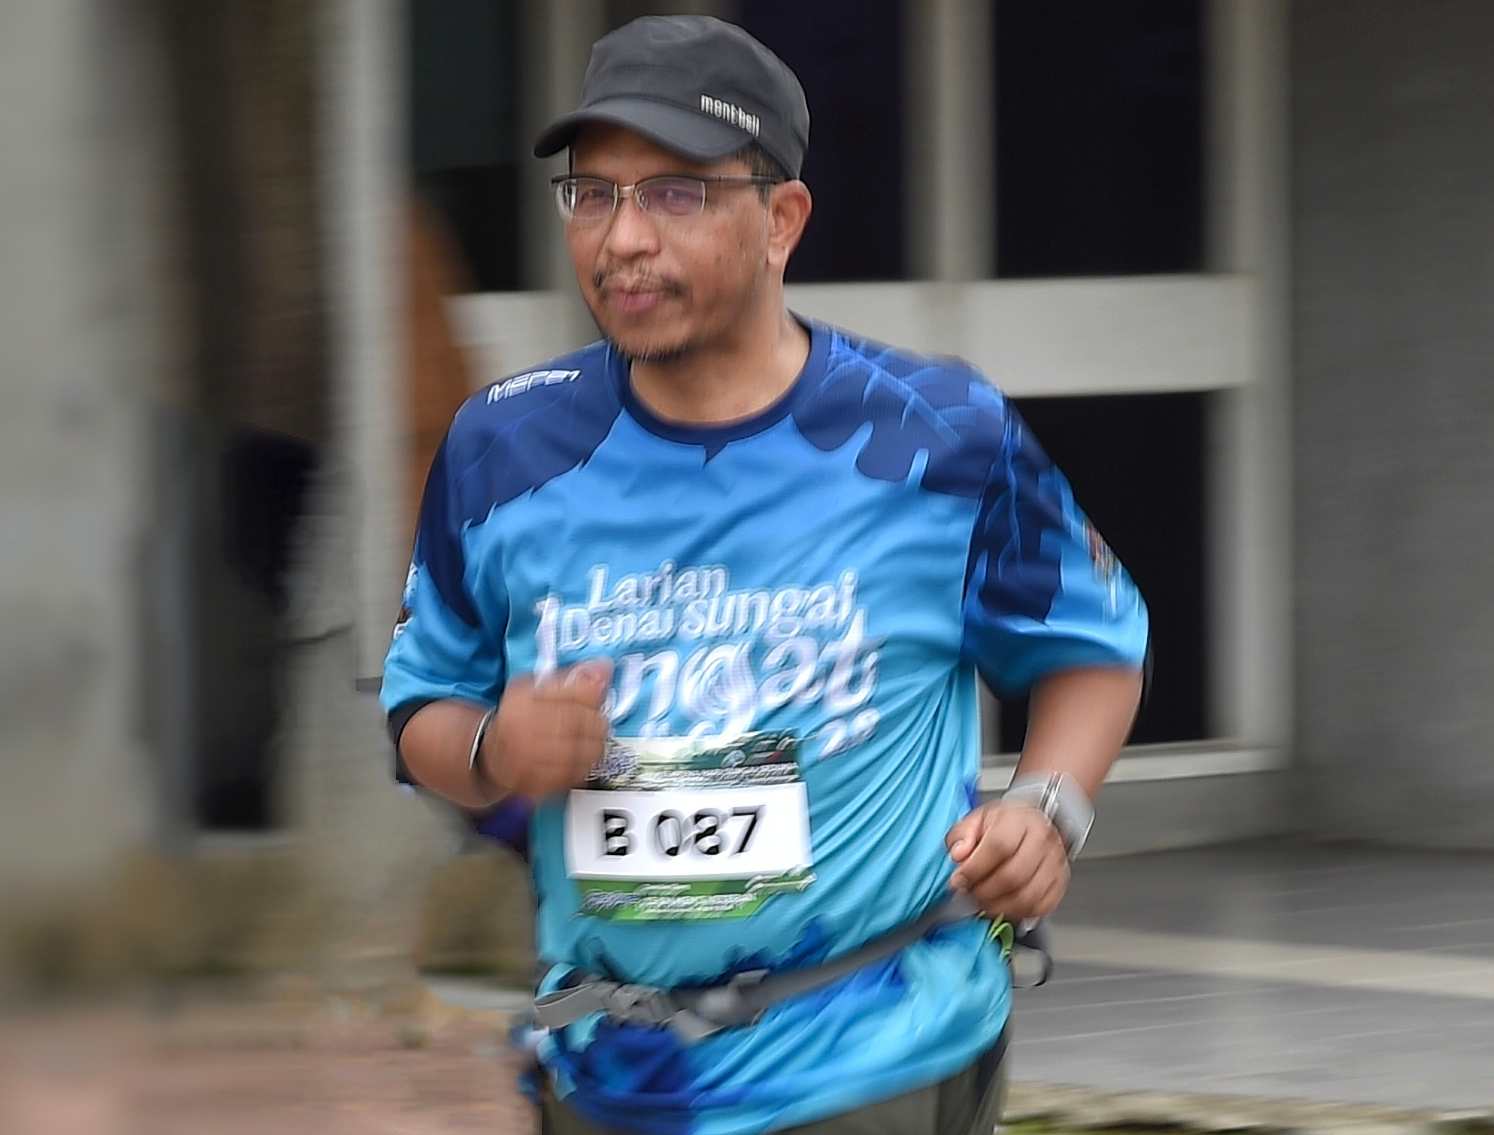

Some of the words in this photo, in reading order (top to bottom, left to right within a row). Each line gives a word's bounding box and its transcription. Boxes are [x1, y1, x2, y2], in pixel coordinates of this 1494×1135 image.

[587, 560, 729, 613] Larian
[559, 604, 677, 652] Denai
[598, 806, 636, 859] B
[649, 804, 767, 859] 087
